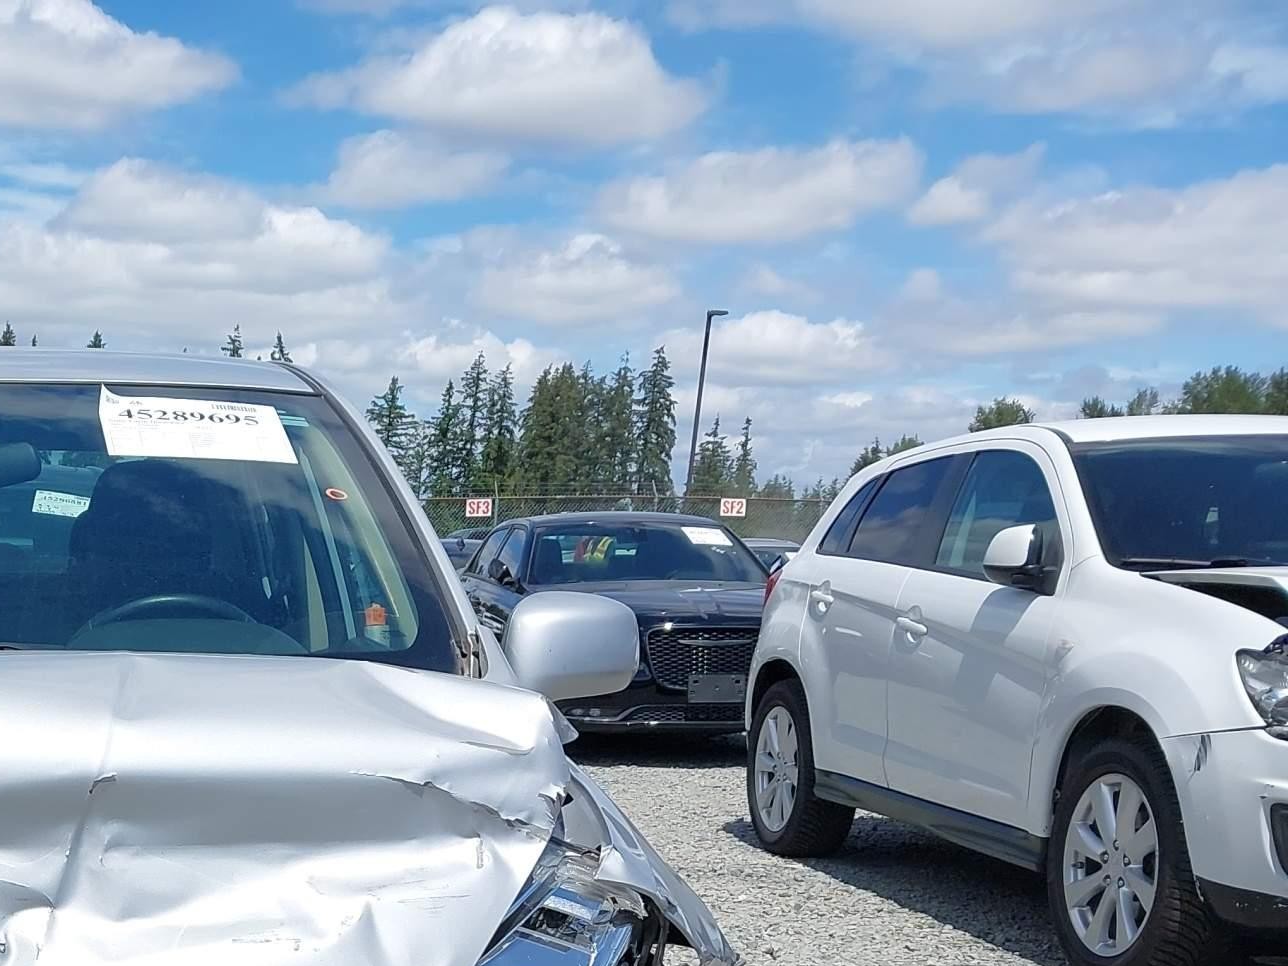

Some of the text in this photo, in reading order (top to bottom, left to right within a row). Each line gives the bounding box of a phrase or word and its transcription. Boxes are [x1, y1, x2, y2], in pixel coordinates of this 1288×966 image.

[118, 408, 260, 426] 45289695
[468, 500, 490, 515] SF3
[722, 500, 744, 514] SF2
